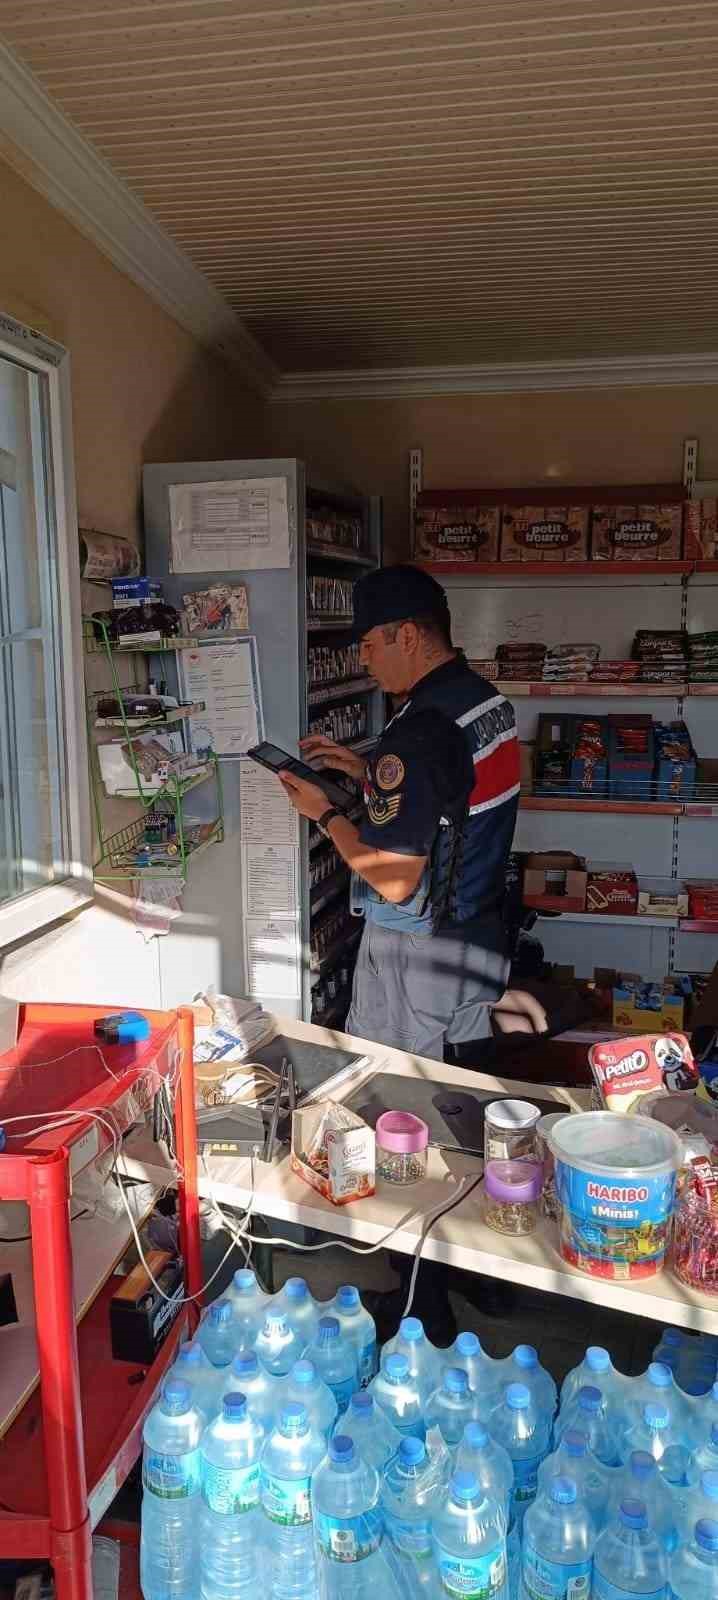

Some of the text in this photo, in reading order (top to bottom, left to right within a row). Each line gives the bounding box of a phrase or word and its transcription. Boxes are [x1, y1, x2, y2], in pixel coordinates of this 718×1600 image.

[443, 525, 473, 538] petit
[532, 523, 562, 537] petit
[620, 520, 652, 534] petit
[437, 533, 479, 546] beurre
[525, 532, 569, 545] beurre
[614, 531, 658, 543] beurre
[472, 702, 515, 749] JANDARM
[588, 1181, 648, 1202] HARIBO
